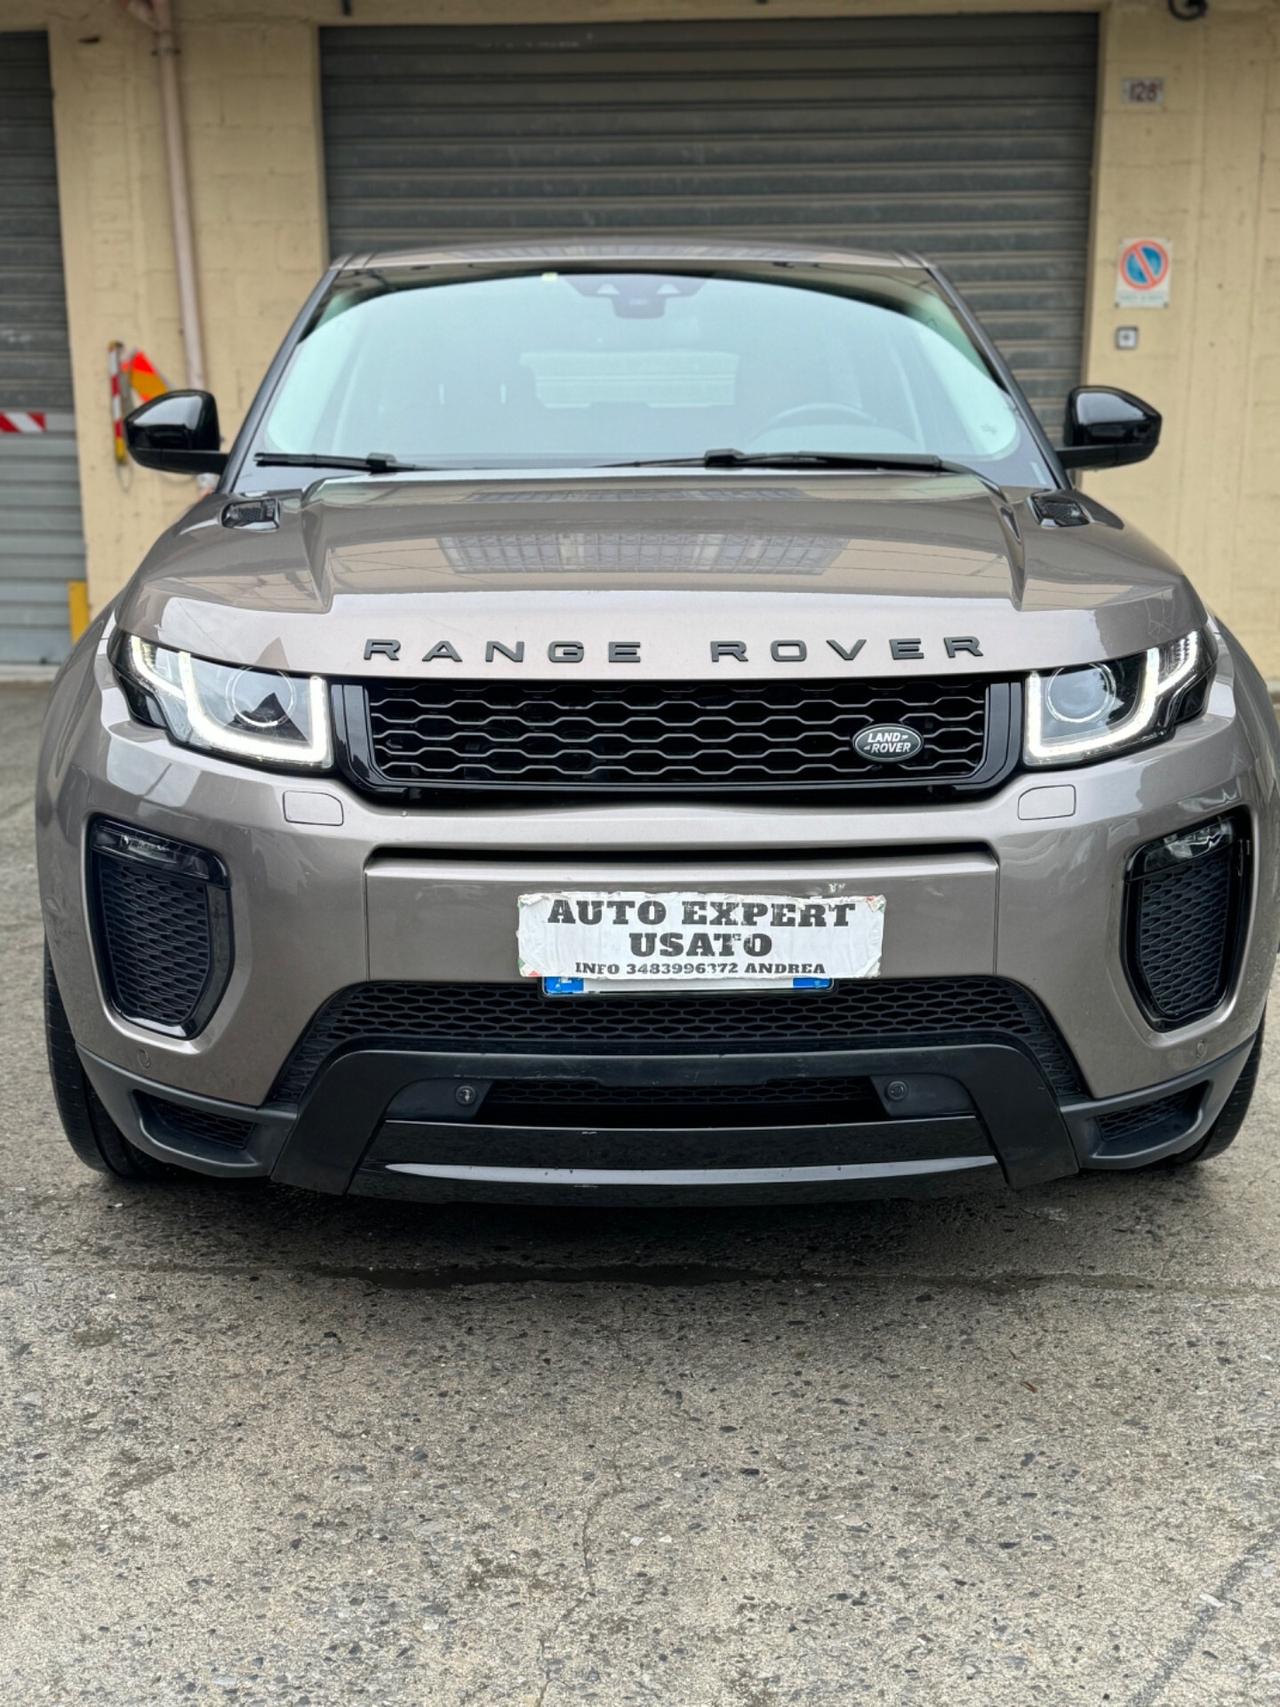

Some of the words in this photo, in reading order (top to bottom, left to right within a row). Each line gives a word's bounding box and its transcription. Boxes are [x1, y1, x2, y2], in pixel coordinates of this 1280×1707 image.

[364, 638, 641, 663] RANGE
[709, 635, 984, 662] ROVER
[867, 732, 901, 743] LAND
[870, 742, 911, 753] ROVER
[547, 900, 666, 925] AUTO
[681, 901, 856, 927] EXPERT
[629, 933, 773, 957] USATO
[576, 962, 620, 975] INFO
[626, 962, 738, 975] 3483996372
[744, 962, 826, 975] ANDREA
